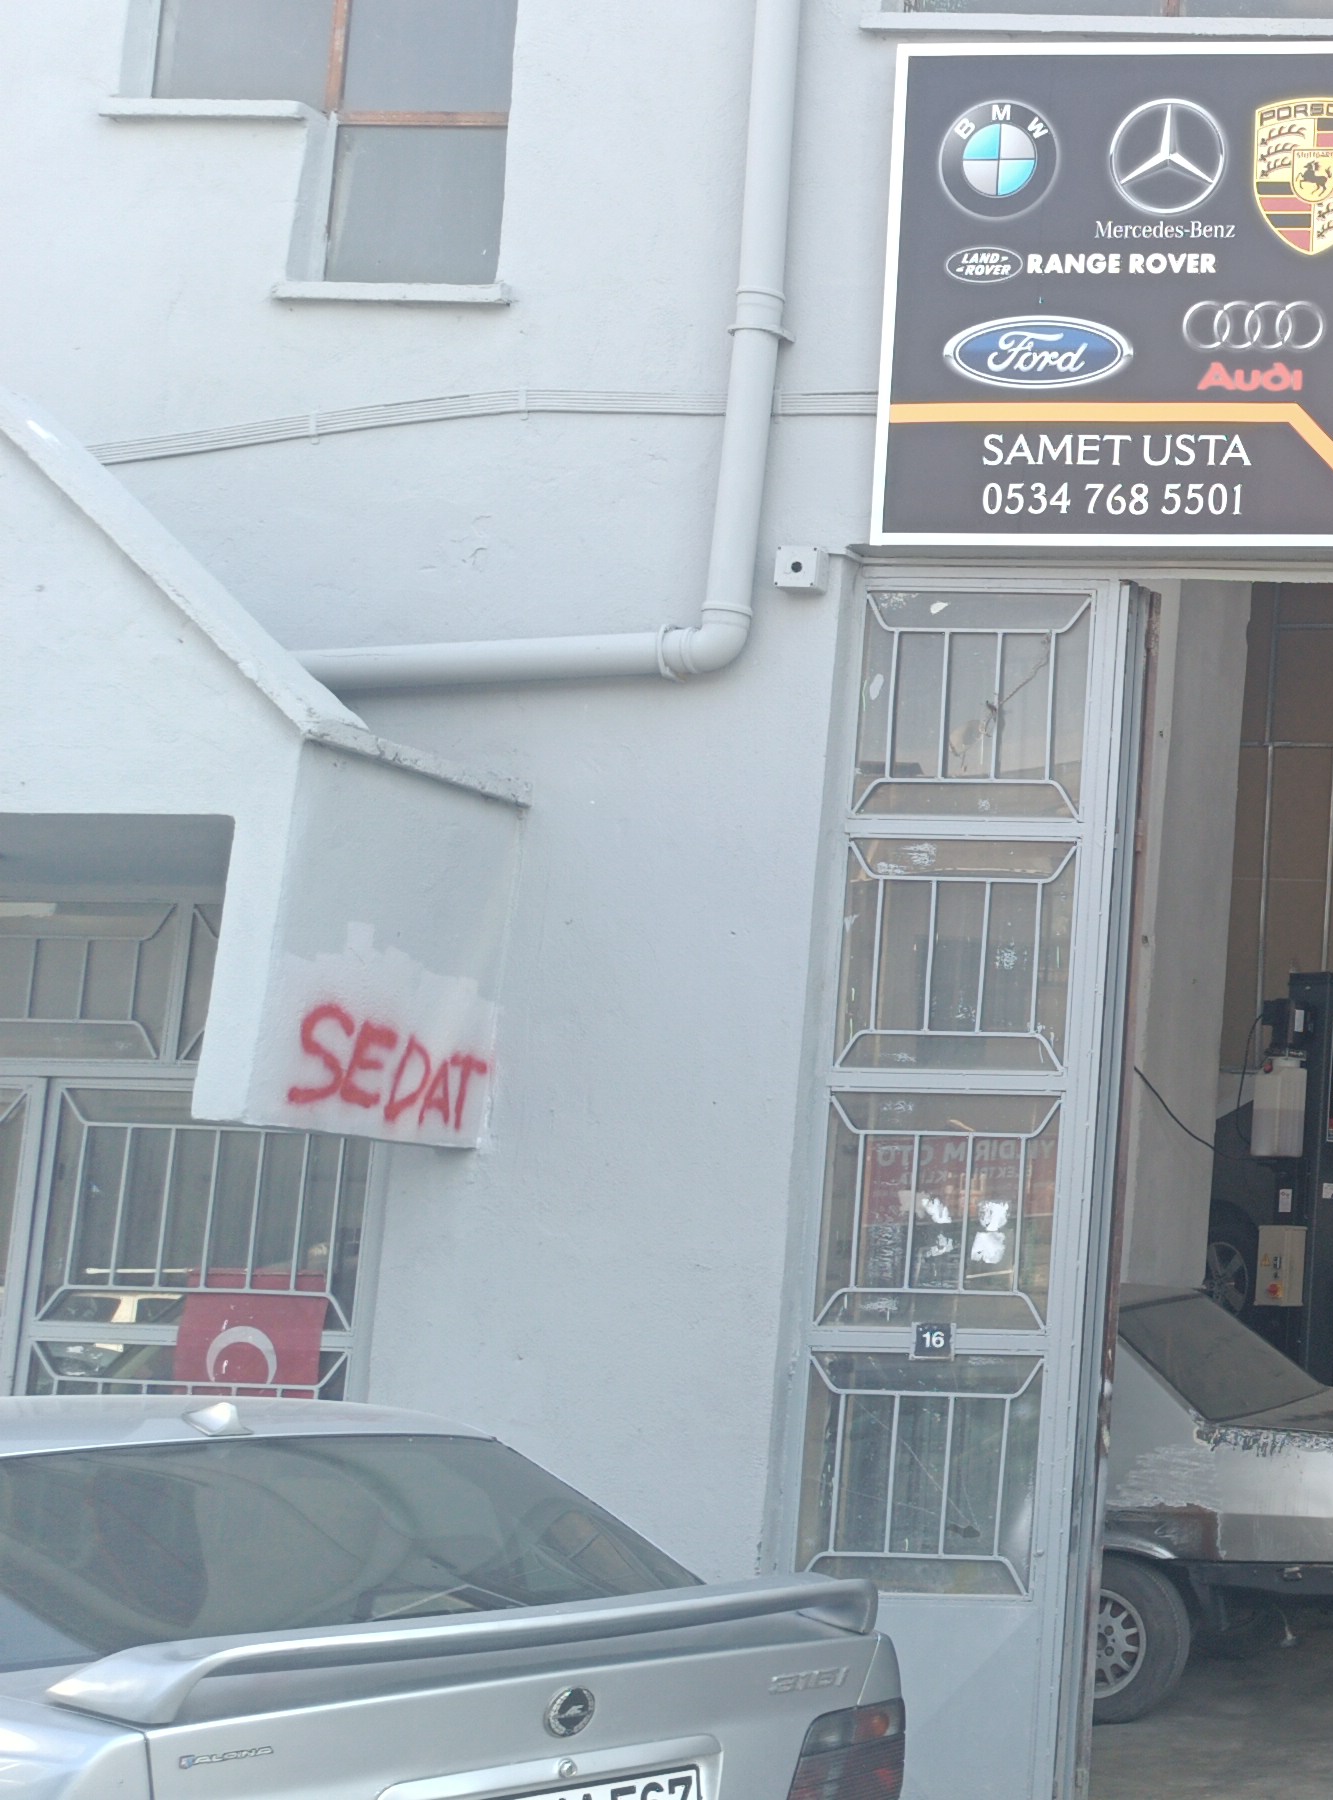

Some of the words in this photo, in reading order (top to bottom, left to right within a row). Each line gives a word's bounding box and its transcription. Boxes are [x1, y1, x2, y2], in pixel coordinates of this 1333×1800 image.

[954, 104, 1048, 140] BMW
[1095, 221, 1235, 239] Mercedes-Benz
[1027, 254, 1120, 274] RANGE
[1128, 254, 1216, 274] ROVER
[987, 331, 1087, 374] Ford
[1198, 362, 1302, 391] Audi
[982, 434, 1132, 466] SAMET
[1142, 435, 1252, 466] USTA
[982, 482, 1070, 515] 0534
[1084, 483, 1149, 515] 768
[1161, 483, 1243, 515] 5501
[286, 1000, 488, 1133] SEDAT
[922, 1331, 945, 1348] 16
